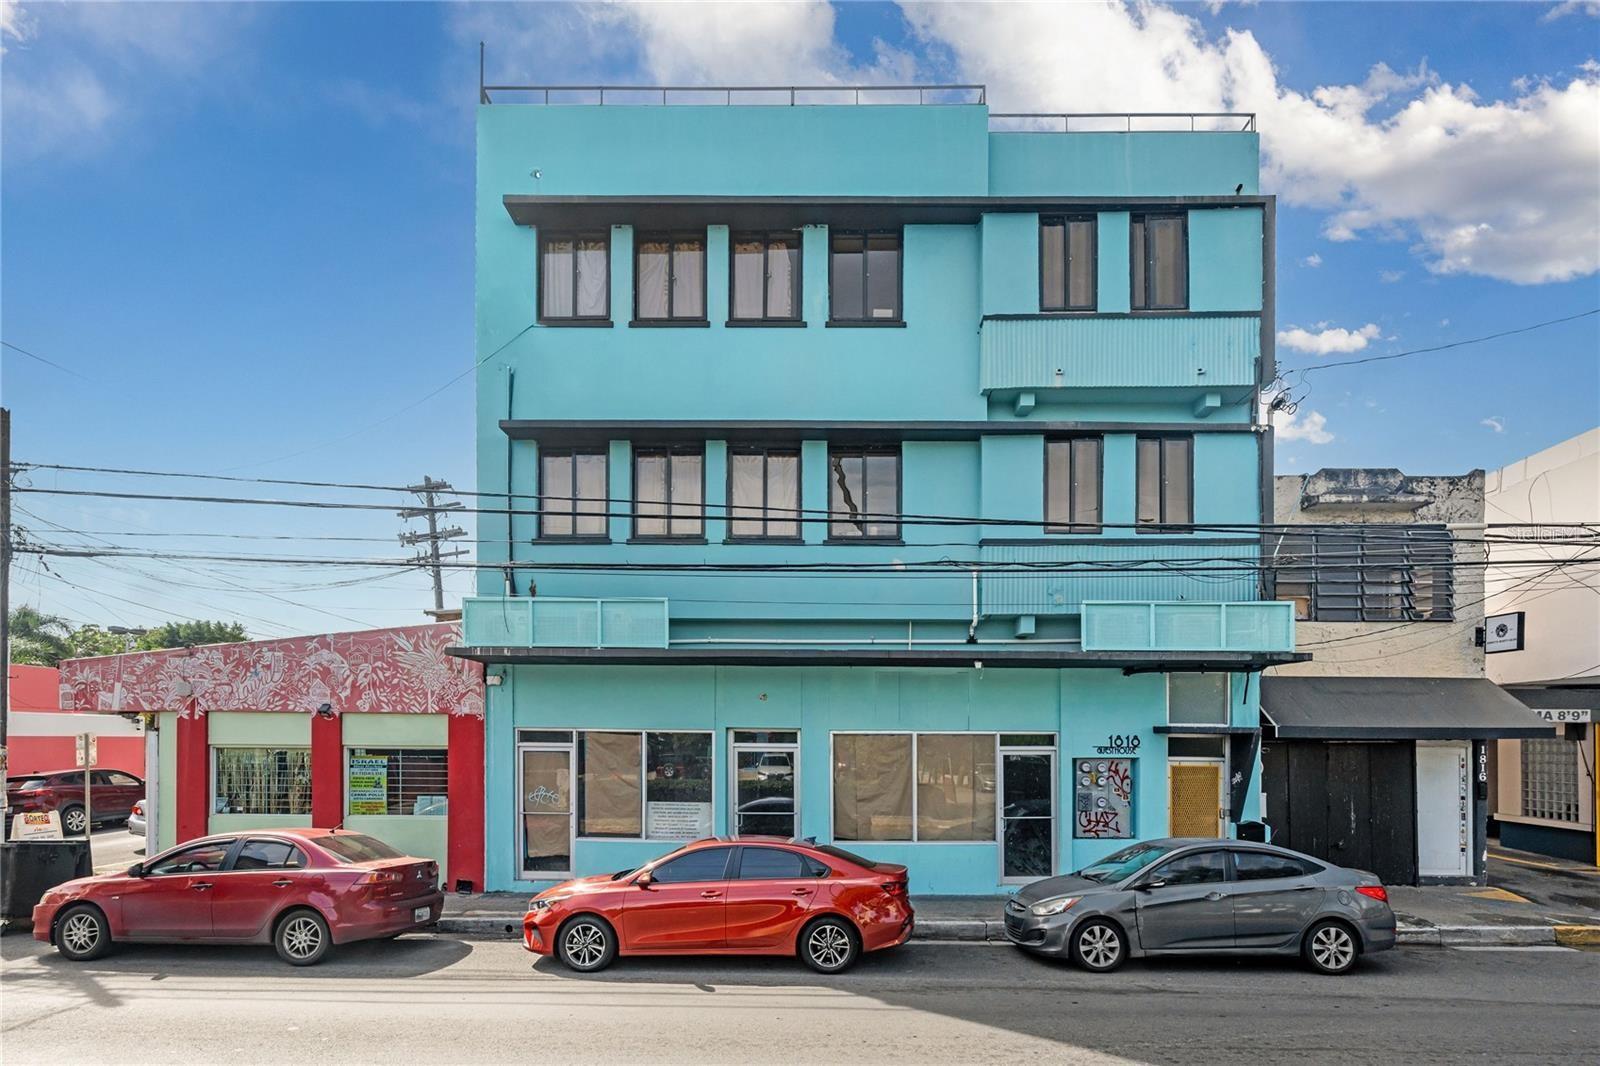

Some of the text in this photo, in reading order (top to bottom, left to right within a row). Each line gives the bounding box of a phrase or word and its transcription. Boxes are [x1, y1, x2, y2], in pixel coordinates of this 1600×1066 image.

[1108, 735, 1140, 748] 1818
[1478, 745, 1487, 782] 1816
[1079, 811, 1121, 833] CHAZ
